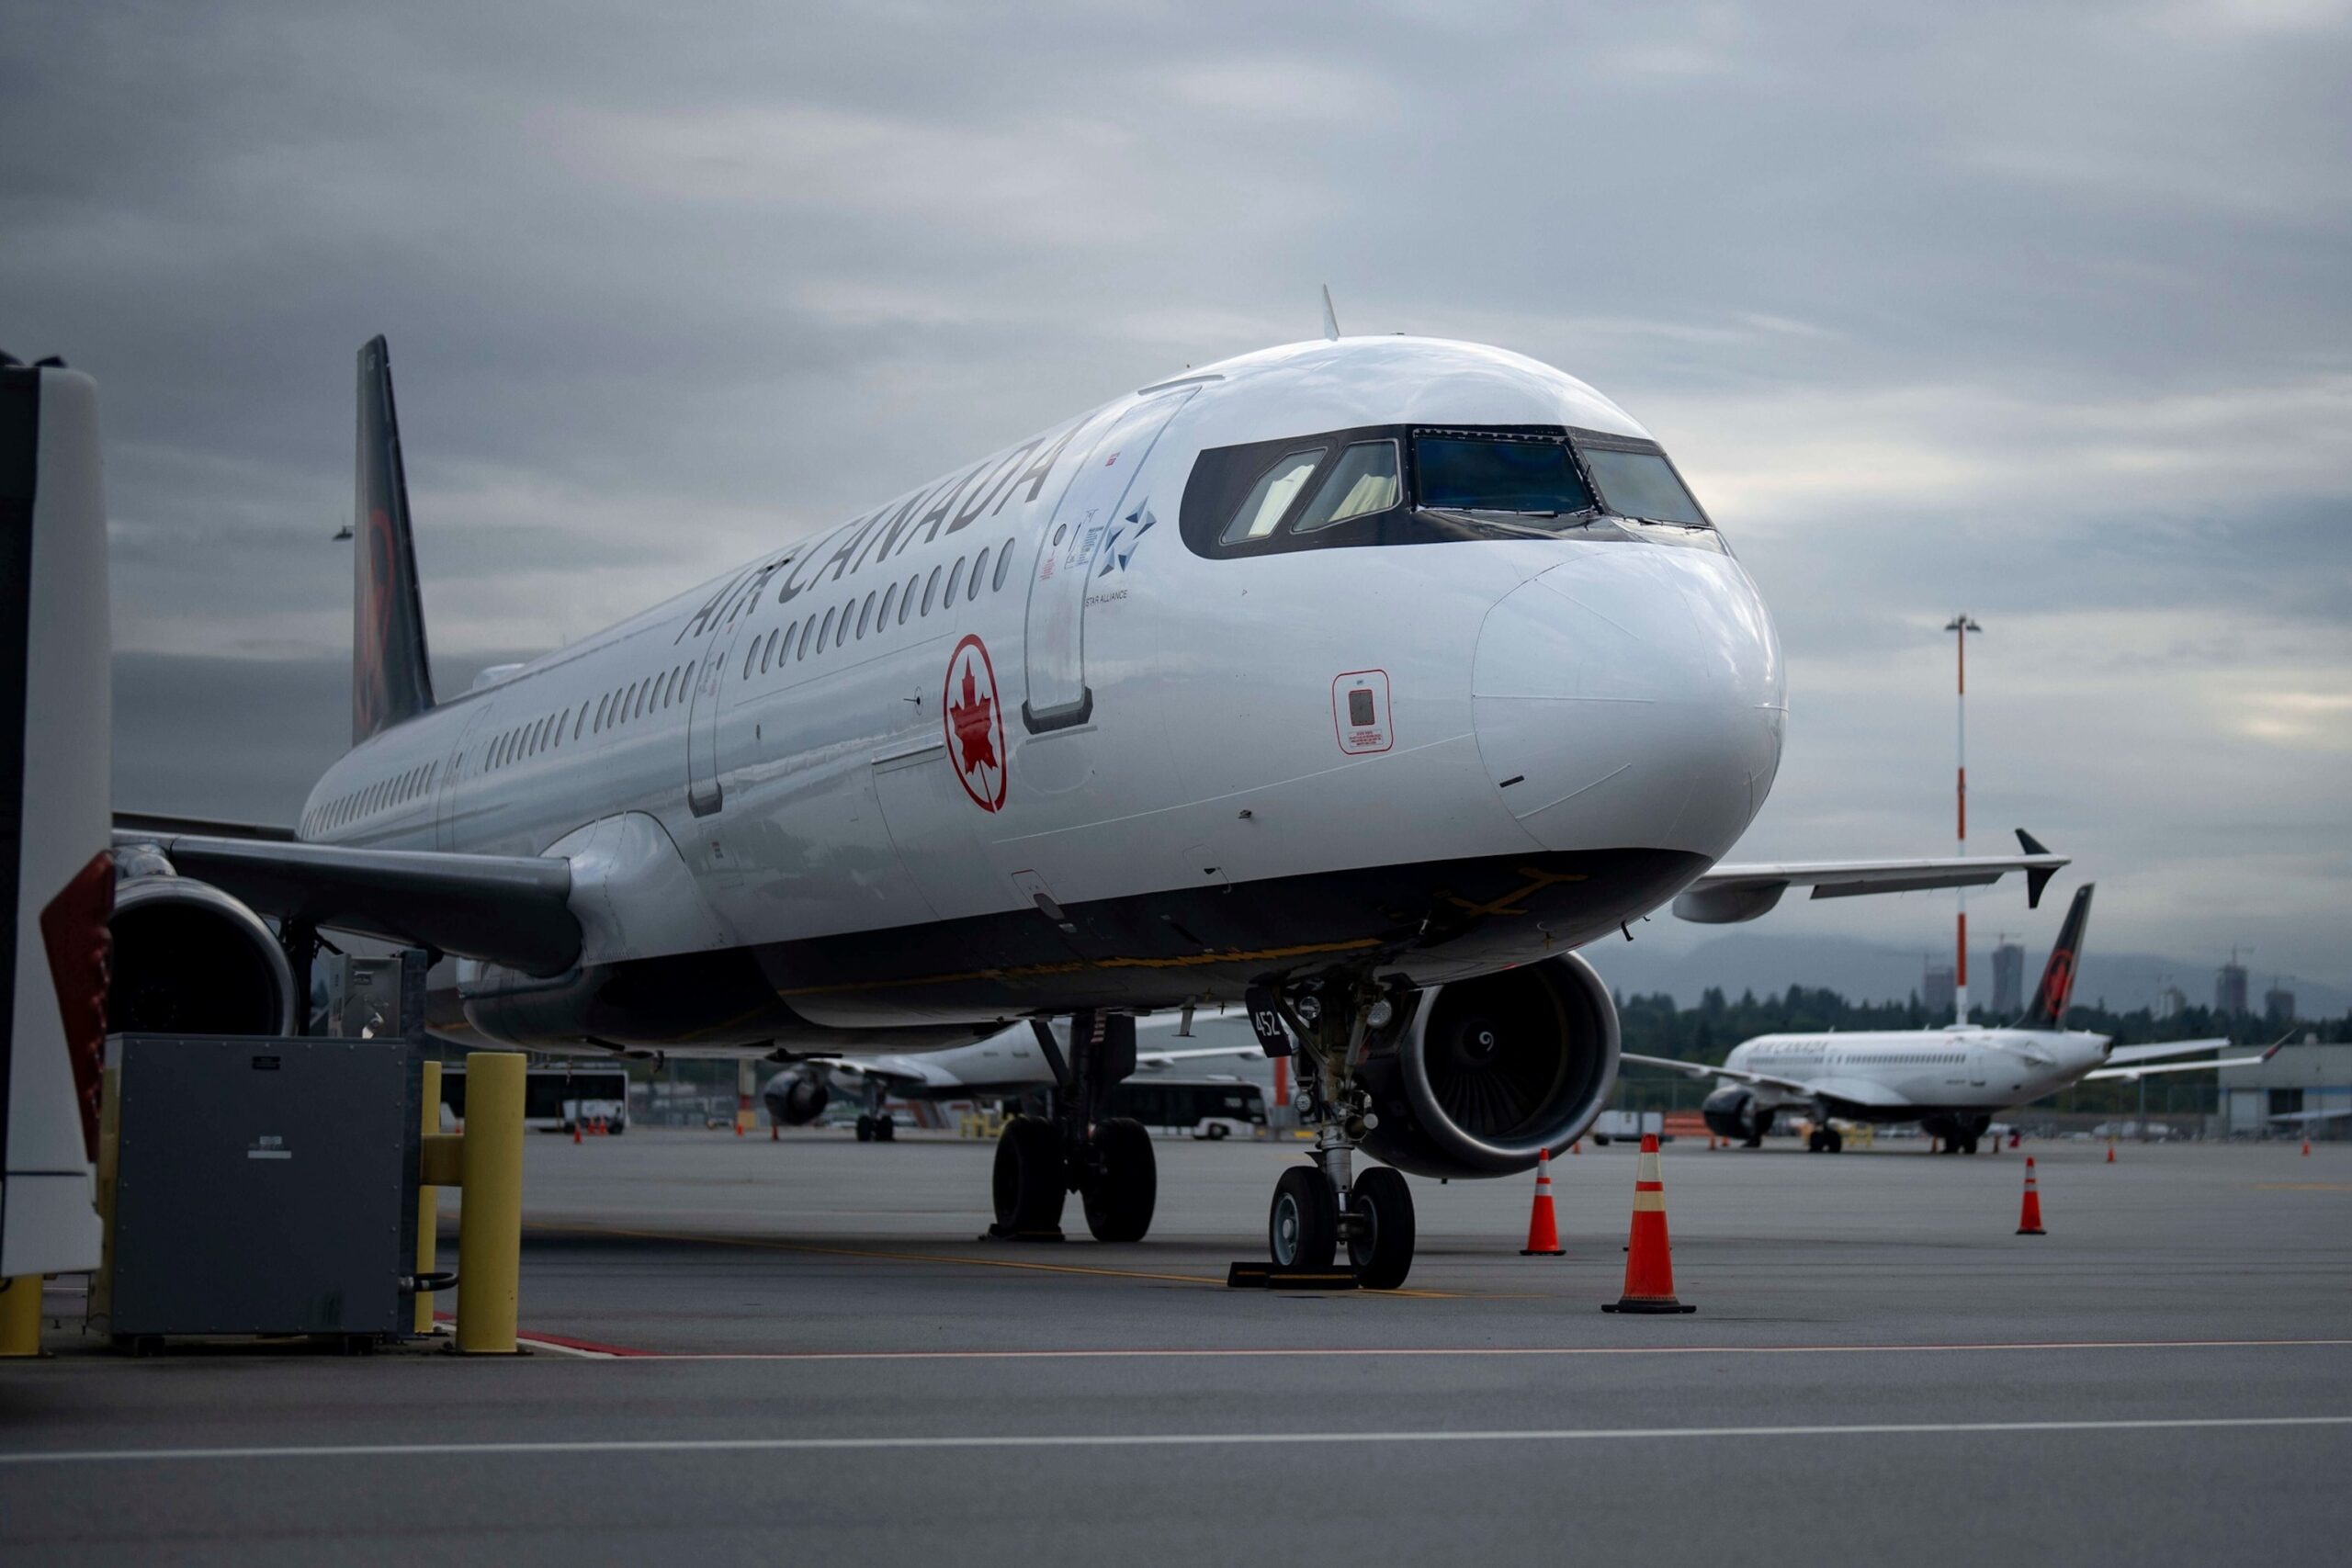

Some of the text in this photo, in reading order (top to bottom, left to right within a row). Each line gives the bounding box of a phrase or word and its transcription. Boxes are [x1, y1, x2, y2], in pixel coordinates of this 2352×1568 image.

[674, 414, 1095, 646] AIR CANADA
[1085, 589, 1128, 607] STAR ALLIANCE
[1255, 1010, 1281, 1036] 452
